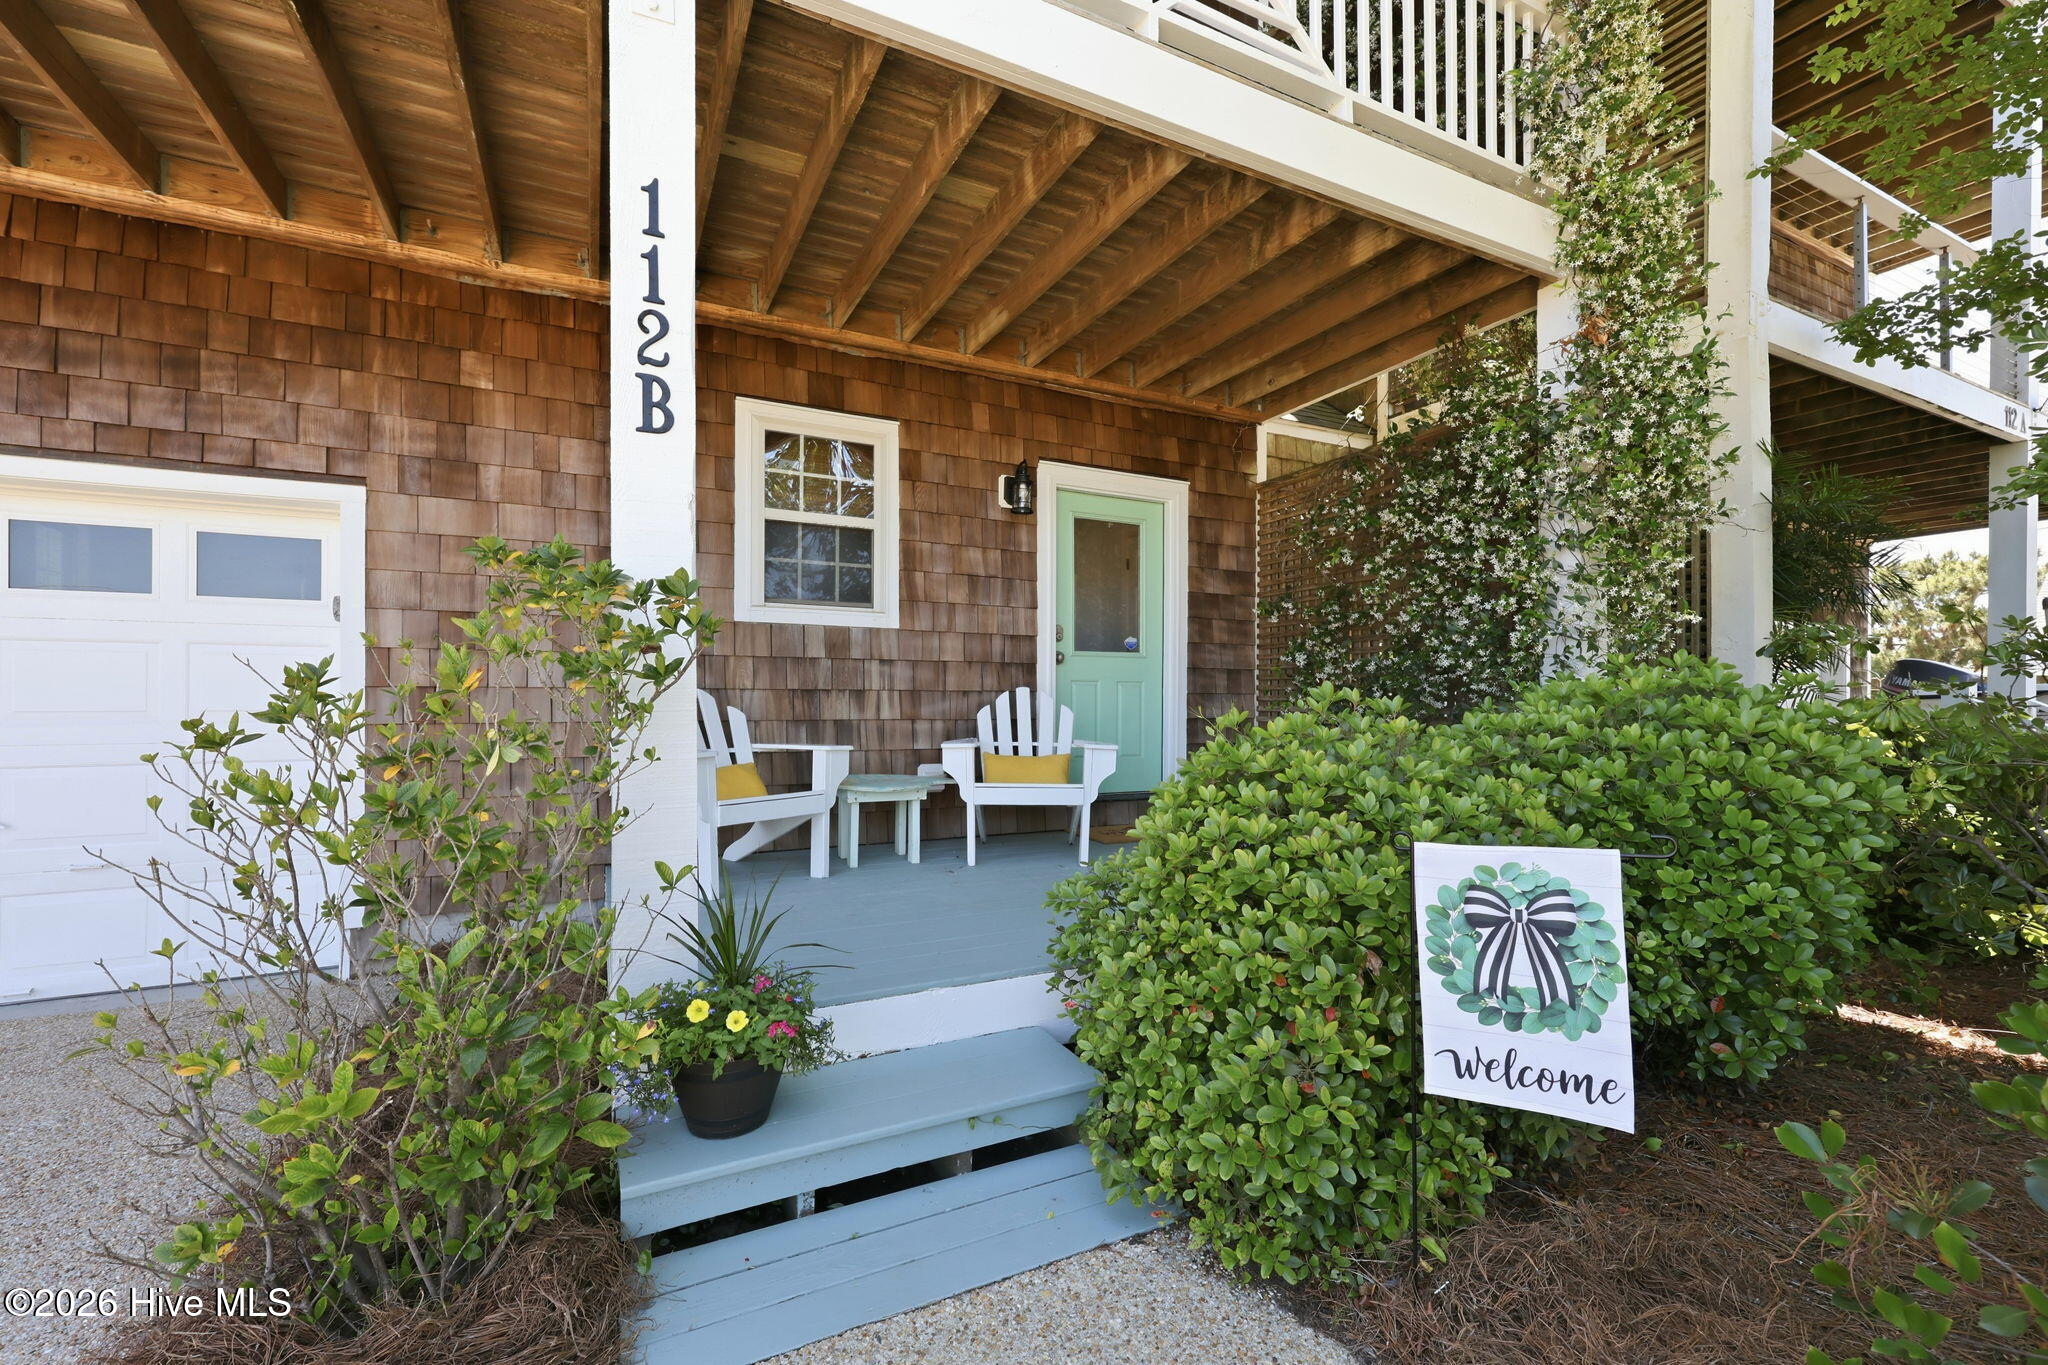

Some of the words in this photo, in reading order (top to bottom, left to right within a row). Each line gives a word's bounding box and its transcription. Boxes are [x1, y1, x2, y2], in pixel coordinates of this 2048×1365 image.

[635, 177, 675, 435] 112B
[2004, 405, 2018, 431] 112
[2020, 412, 2026, 434] A
[1433, 1046, 1626, 1105] Welcome
